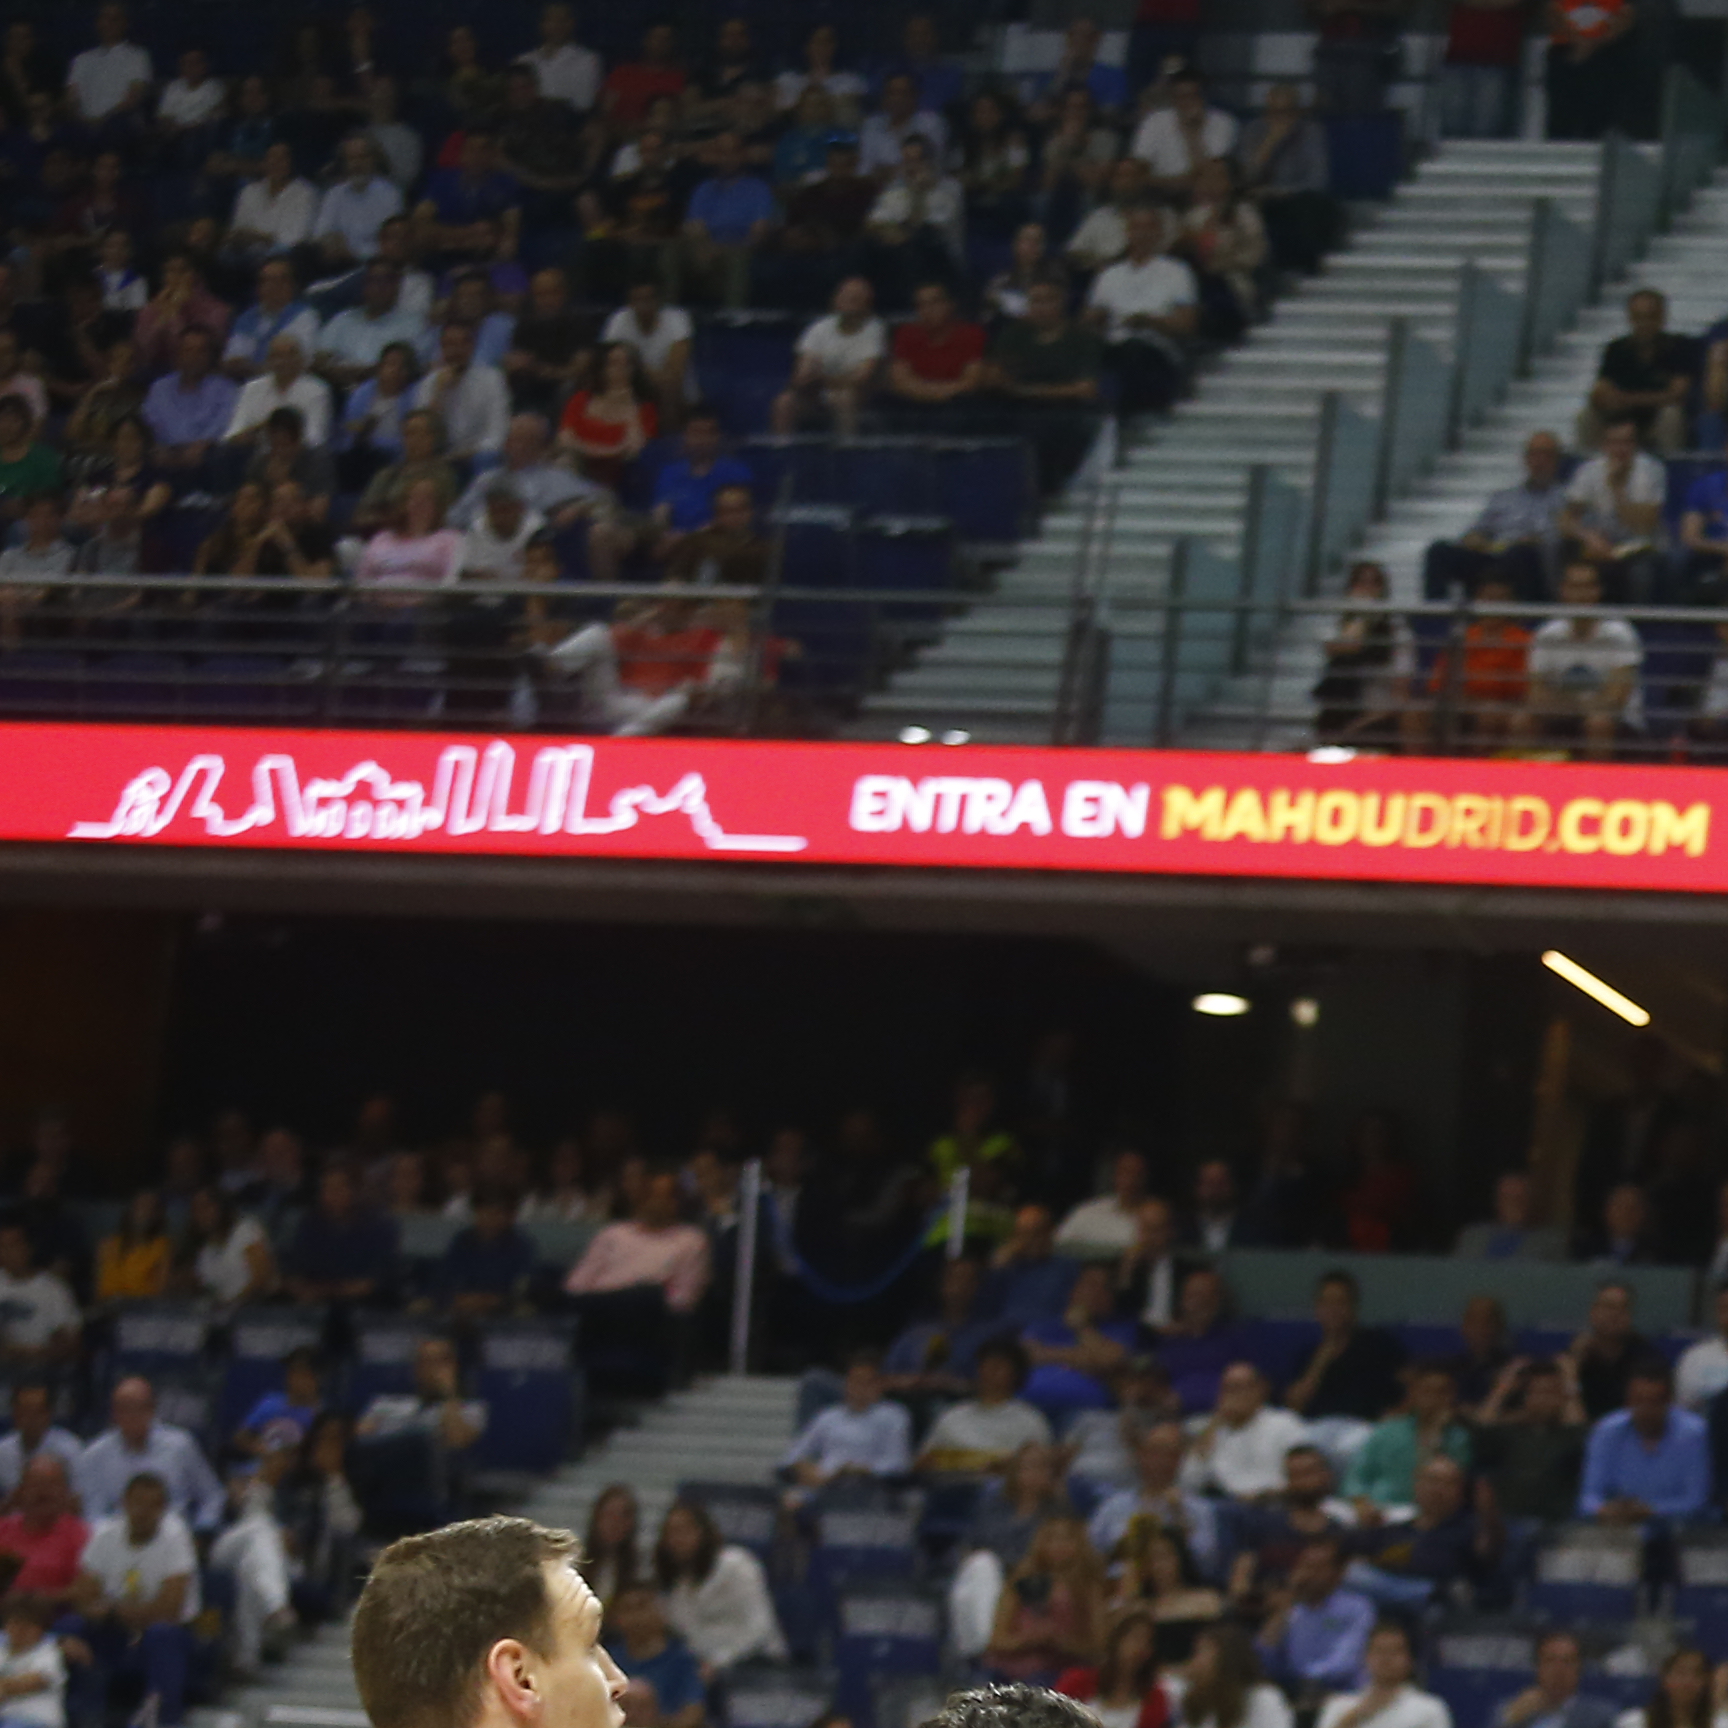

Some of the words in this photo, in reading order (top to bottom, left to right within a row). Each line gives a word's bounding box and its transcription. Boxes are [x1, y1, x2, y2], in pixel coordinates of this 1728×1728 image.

[848, 773, 1053, 836] ENTRA
[1060, 779, 1151, 839] EN
[1160, 784, 1711, 857] MAHOUDRID.COM
